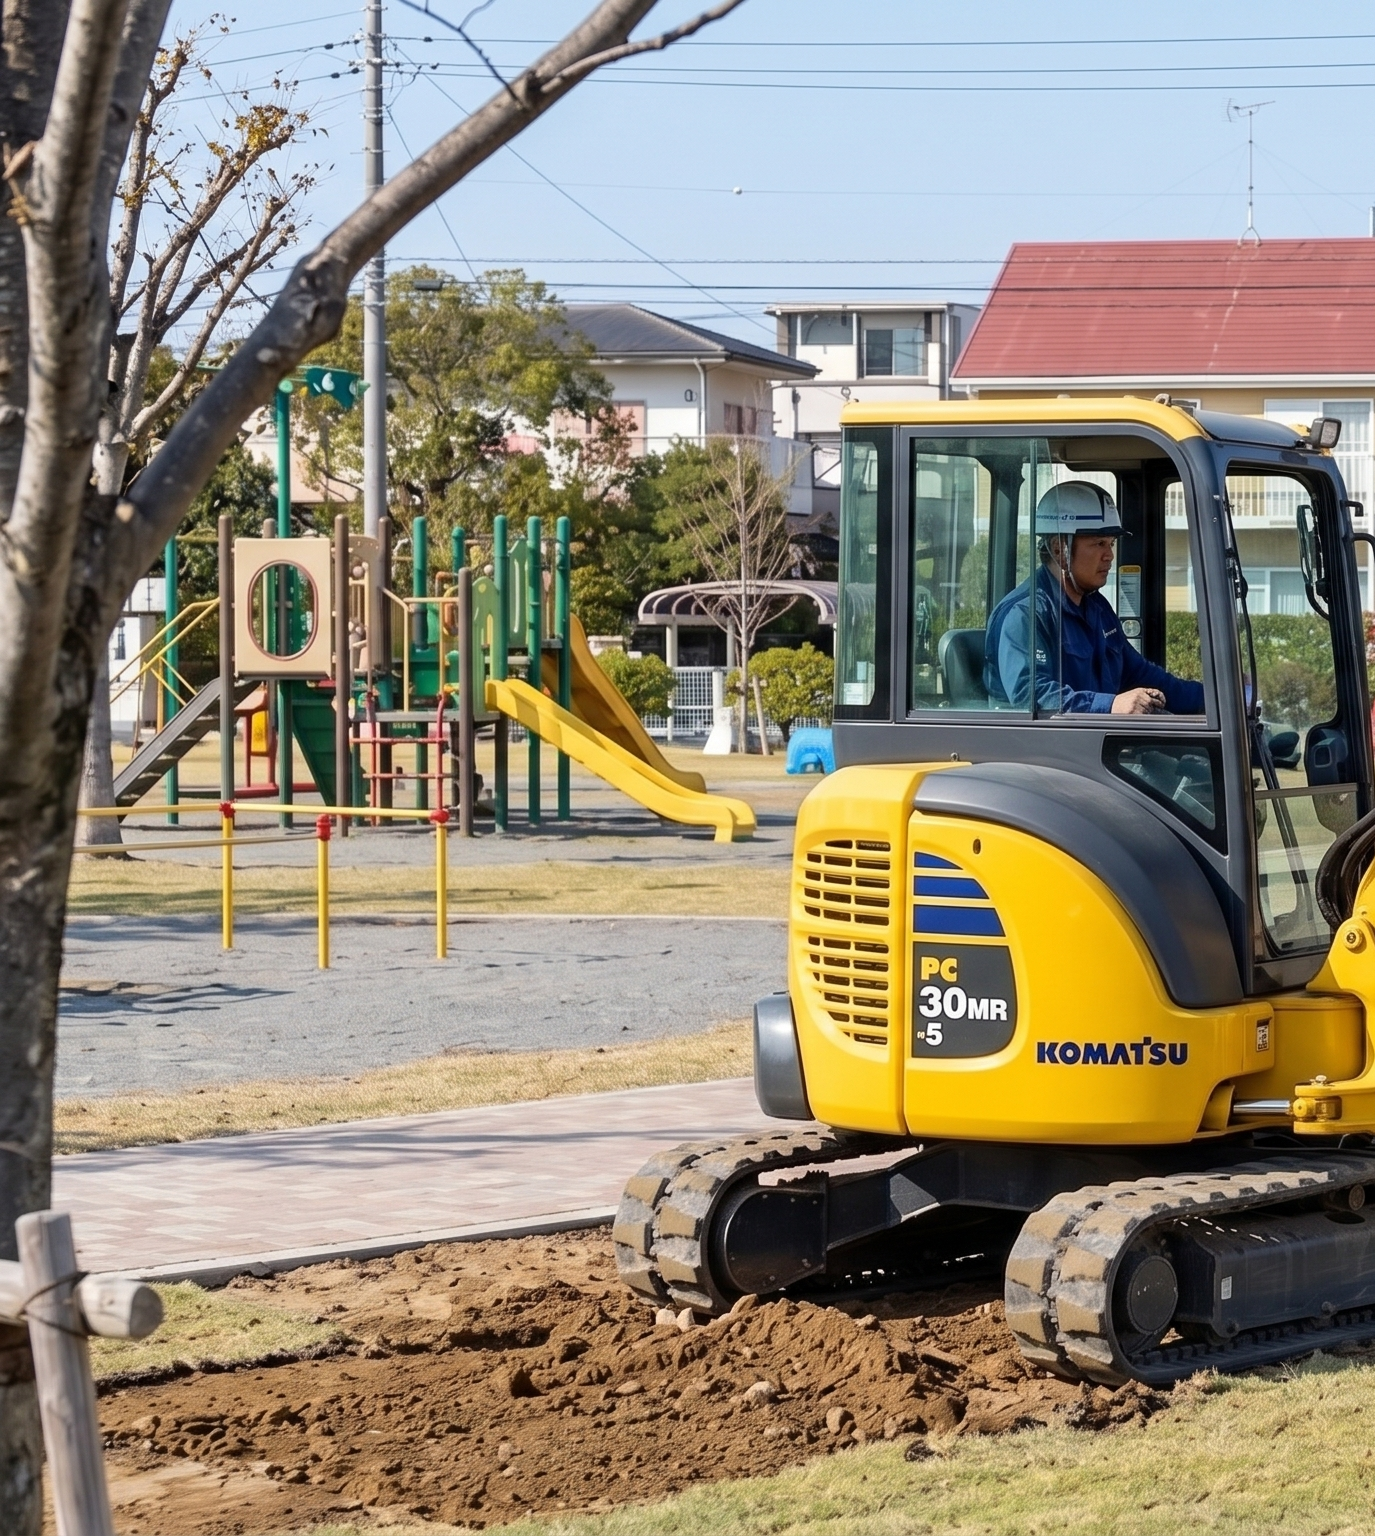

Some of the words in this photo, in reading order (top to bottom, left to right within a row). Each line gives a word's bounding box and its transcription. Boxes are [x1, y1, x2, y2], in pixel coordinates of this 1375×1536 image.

[920, 956, 958, 982] PC
[918, 985, 1008, 1021] 30MR
[1036, 1036, 1189, 1066] KOMATSU
